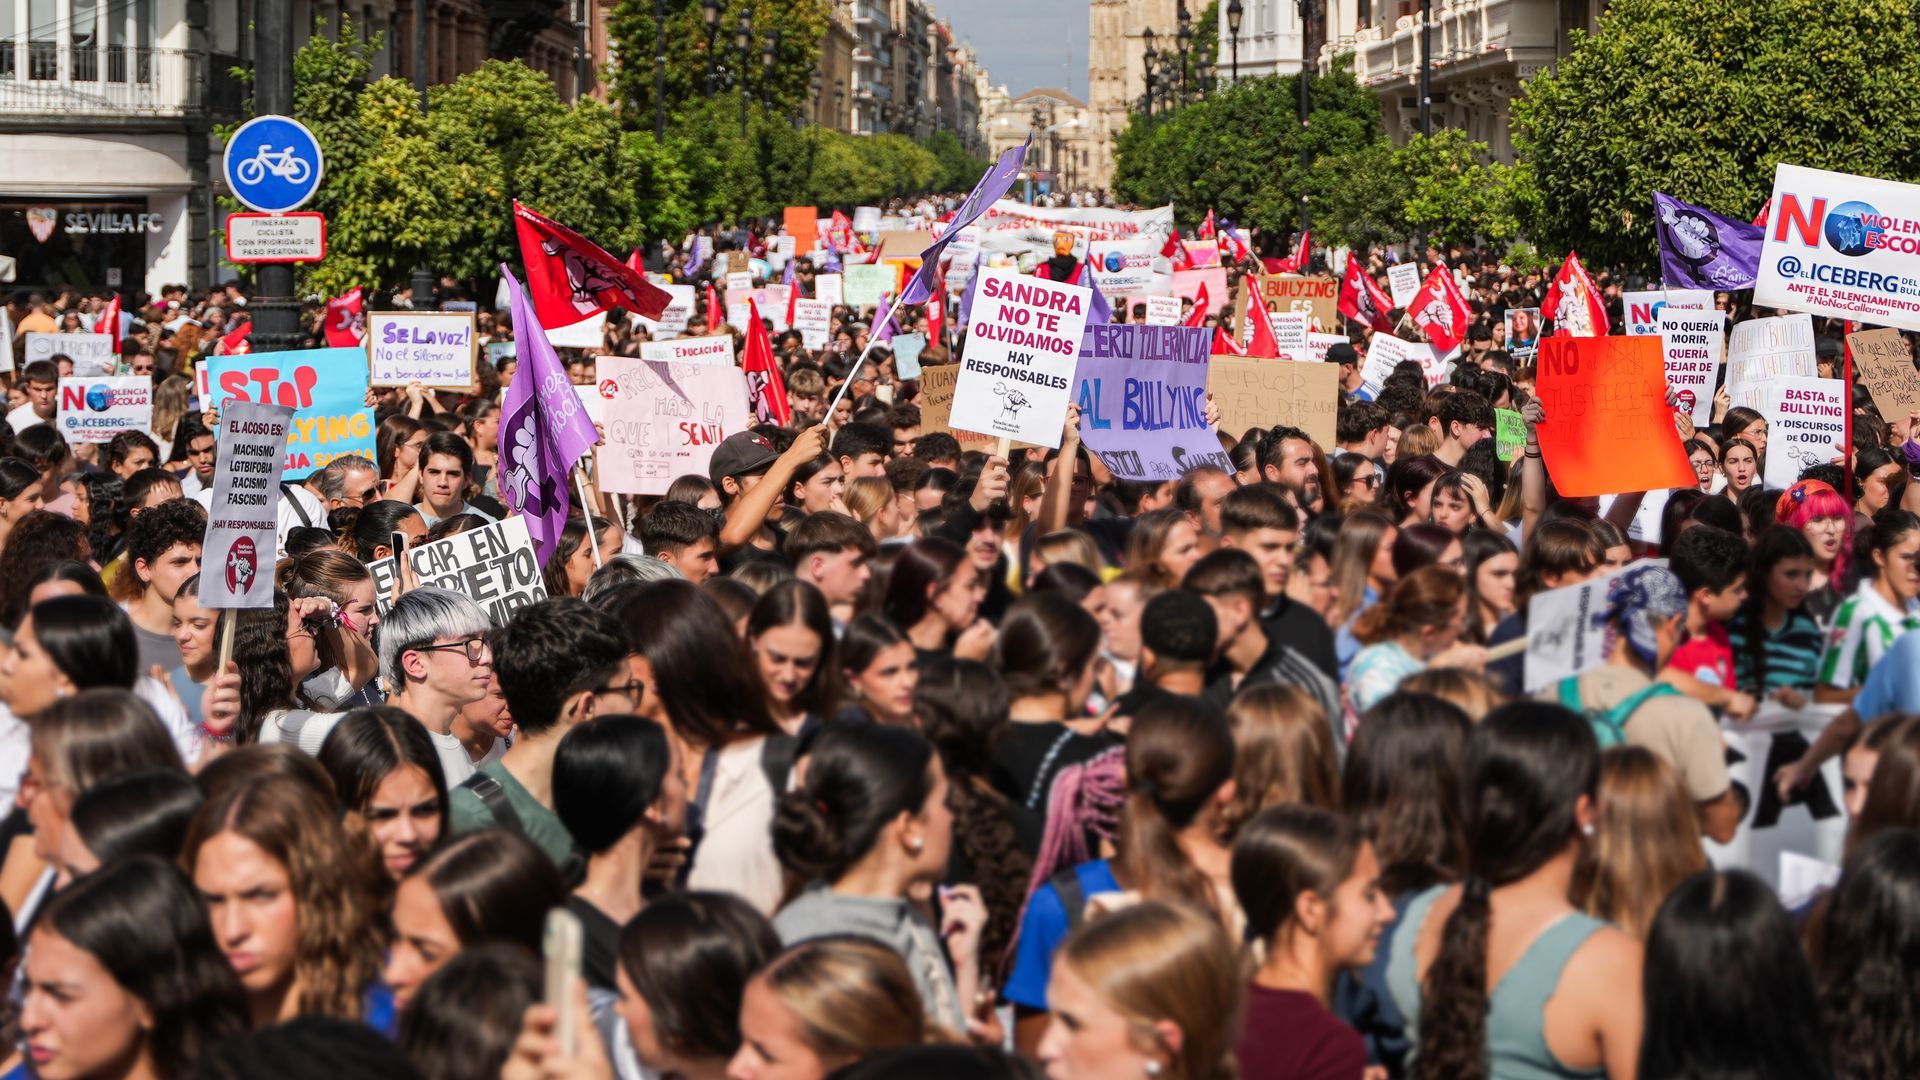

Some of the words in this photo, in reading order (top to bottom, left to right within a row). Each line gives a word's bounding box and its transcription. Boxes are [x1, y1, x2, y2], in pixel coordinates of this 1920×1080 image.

[64, 213, 135, 233] SEVILLA
[137, 212, 163, 233] FC
[251, 219, 300, 227] ITINERARIO
[1860, 212, 1920, 235] VIOLEN
[1865, 231, 1920, 256] ESCOL
[242, 248, 265, 256] PASO
[1810, 263, 1899, 293] ICEBERG
[982, 277, 1082, 316] SANDRA
[1787, 282, 1816, 296] ANTE
[1818, 288, 1830, 298] EL
[1832, 290, 1920, 312] SILENCIAMIENTO
[1806, 296, 1890, 317] #NoNosCallaran
[998, 305, 1030, 326] NO
[1036, 312, 1061, 333] TE
[1662, 321, 1679, 331] NO
[1681, 319, 1719, 332] QUERÍA
[975, 322, 1074, 356] OLVIDAMOS
[1079, 325, 1135, 359] CERO
[1138, 325, 1208, 364] TOLERANCIA
[1671, 334, 1710, 346] MORIR,
[376, 347, 393, 361] No
[1007, 350, 1034, 367] HAY
[1544, 340, 1580, 376] NO
[1669, 346, 1709, 359] QUERÍA
[966, 358, 1068, 390] RESPONSABLES
[1664, 362, 1697, 372] DEJAR
[1699, 362, 1713, 372] DE
[219, 365, 318, 409] STOP
[1667, 374, 1706, 385] SUFRIR
[105, 397, 148, 406] ESCOLAR
[1077, 378, 1112, 430] AL
[1122, 377, 1208, 431] BULLYING
[1785, 389, 1826, 403] BASTA
[1828, 396, 1840, 404] DE
[654, 394, 694, 419] MÁS
[702, 401, 725, 426] LO
[1780, 402, 1842, 417] BULLYING
[82, 417, 126, 427] ICEBERG
[230, 421, 240, 433] EL
[241, 422, 270, 436] ACOSO
[270, 424, 284, 436] ES:
[1784, 420, 1843, 432] DISCURSOS
[610, 420, 652, 447] QUE
[1786, 434, 1798, 442] DE
[1800, 433, 1832, 445] ODIO
[232, 443, 275, 457] MACHISMO
[229, 460, 273, 474] LGTBIFOBIA
[1149, 459, 1178, 479] PARA
[231, 476, 268, 490] RACISMO
[227, 493, 268, 506] FASCISMO
[212, 519, 227, 530] ¡HAY
[227, 519, 275, 530] RESPONSABLES!
[467, 522, 510, 563] EN
